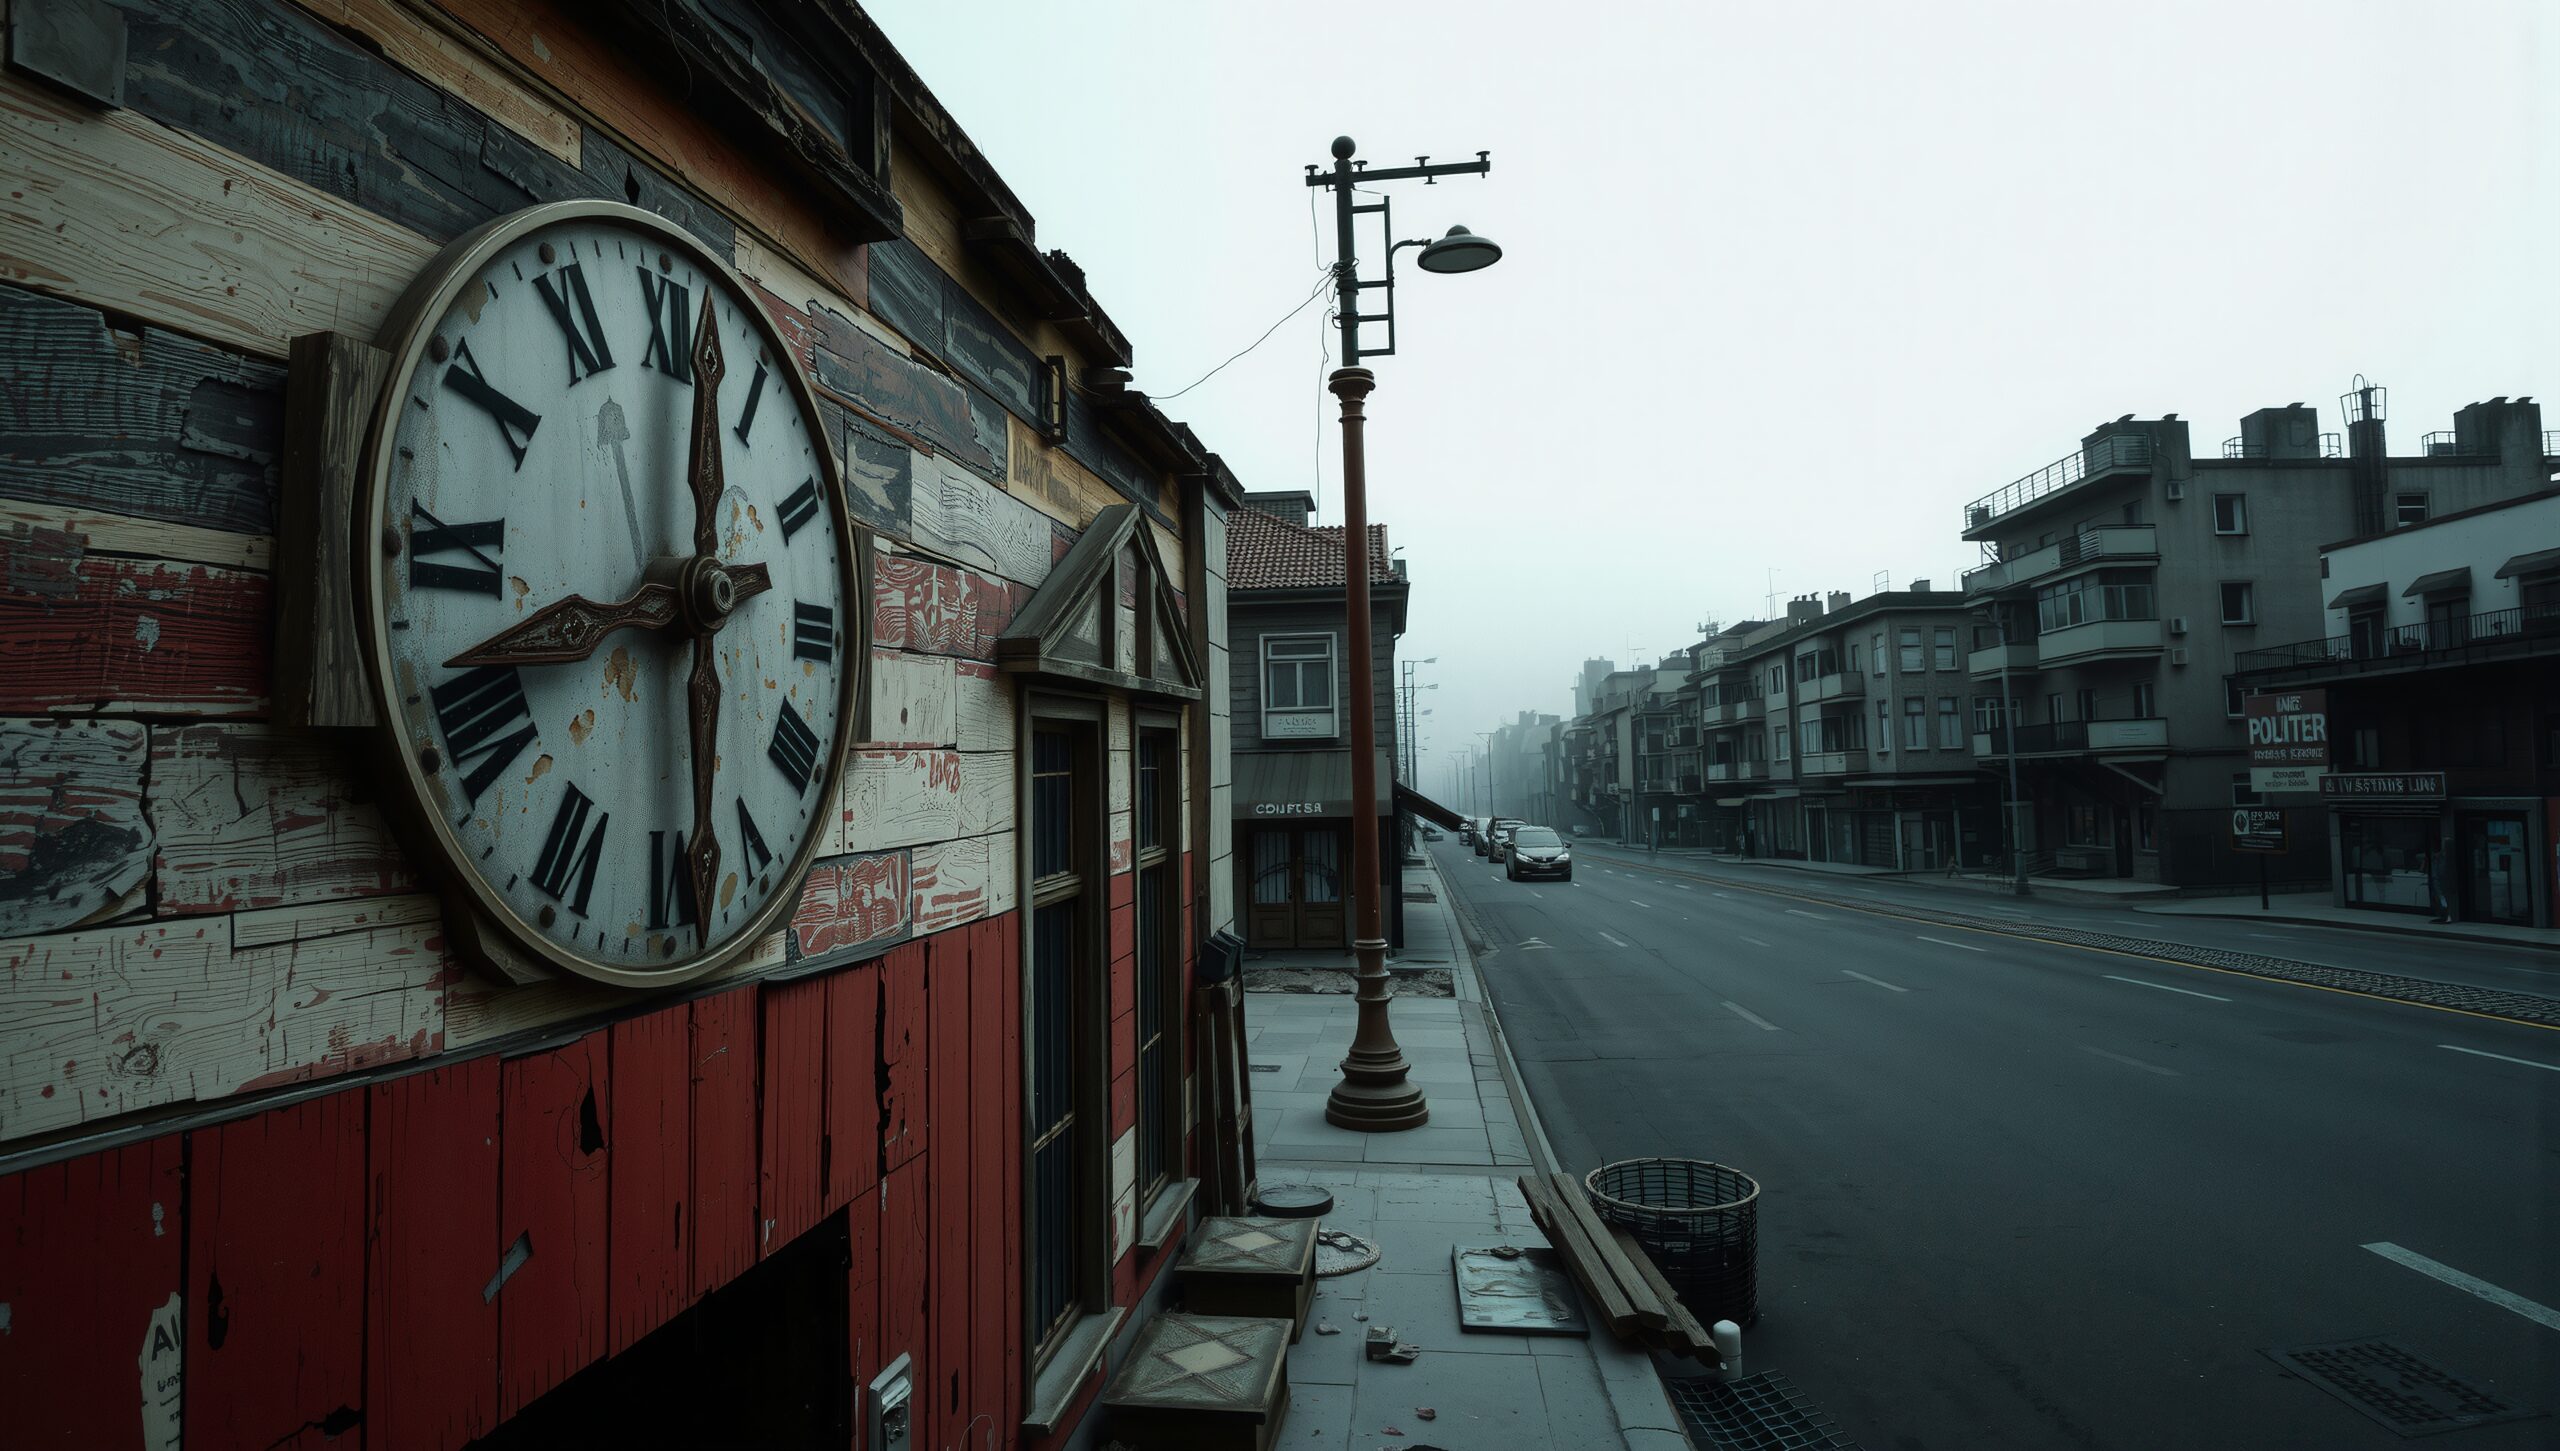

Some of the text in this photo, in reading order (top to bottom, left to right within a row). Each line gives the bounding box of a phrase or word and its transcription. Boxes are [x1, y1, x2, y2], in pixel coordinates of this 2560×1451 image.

[534, 261, 616, 386] XI
[636, 265, 692, 386] XII
[442, 336, 541, 472] X
[733, 360, 768, 448] I
[410, 497, 505, 600] IX
[776, 474, 819, 546] II
[793, 599, 833, 663] III
[528, 781, 609, 919] VII
[736, 794, 773, 888] V
